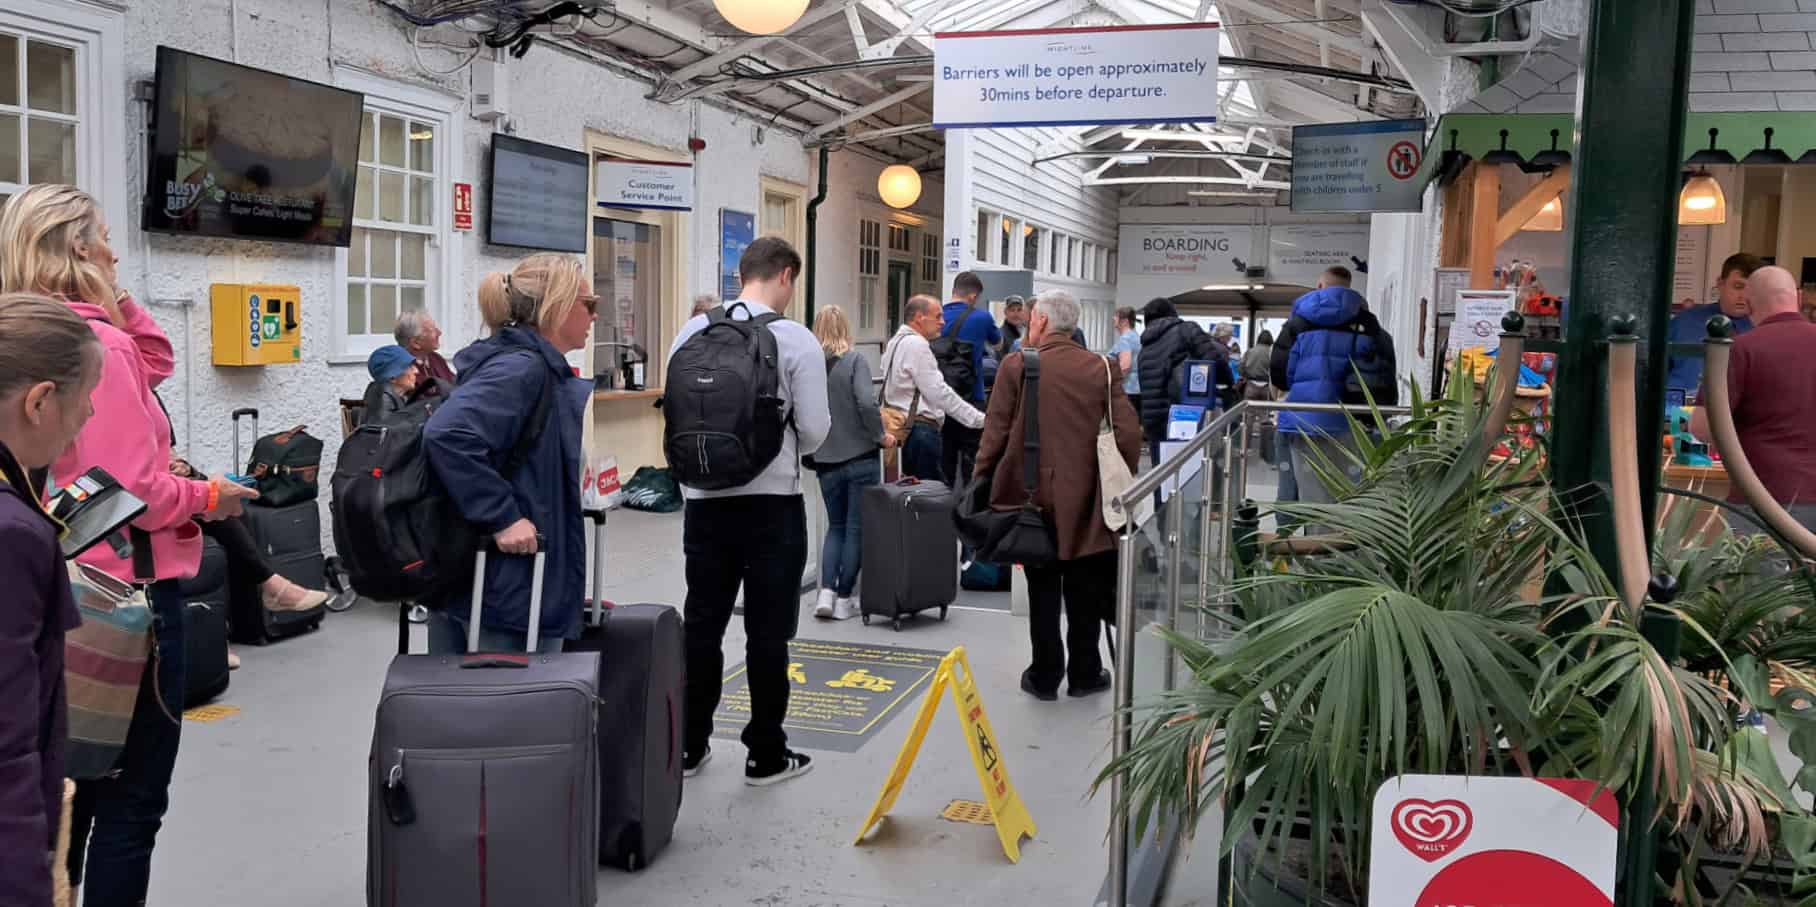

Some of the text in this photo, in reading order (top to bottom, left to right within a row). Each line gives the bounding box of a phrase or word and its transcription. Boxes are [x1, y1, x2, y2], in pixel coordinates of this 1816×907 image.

[943, 58, 1206, 81] Barriers will be open approximately
[979, 84, 1167, 102] 30mins before departure.
[628, 179, 675, 190] Customer
[621, 190, 683, 202] Service Point
[1143, 238, 1230, 251] BOARDING
